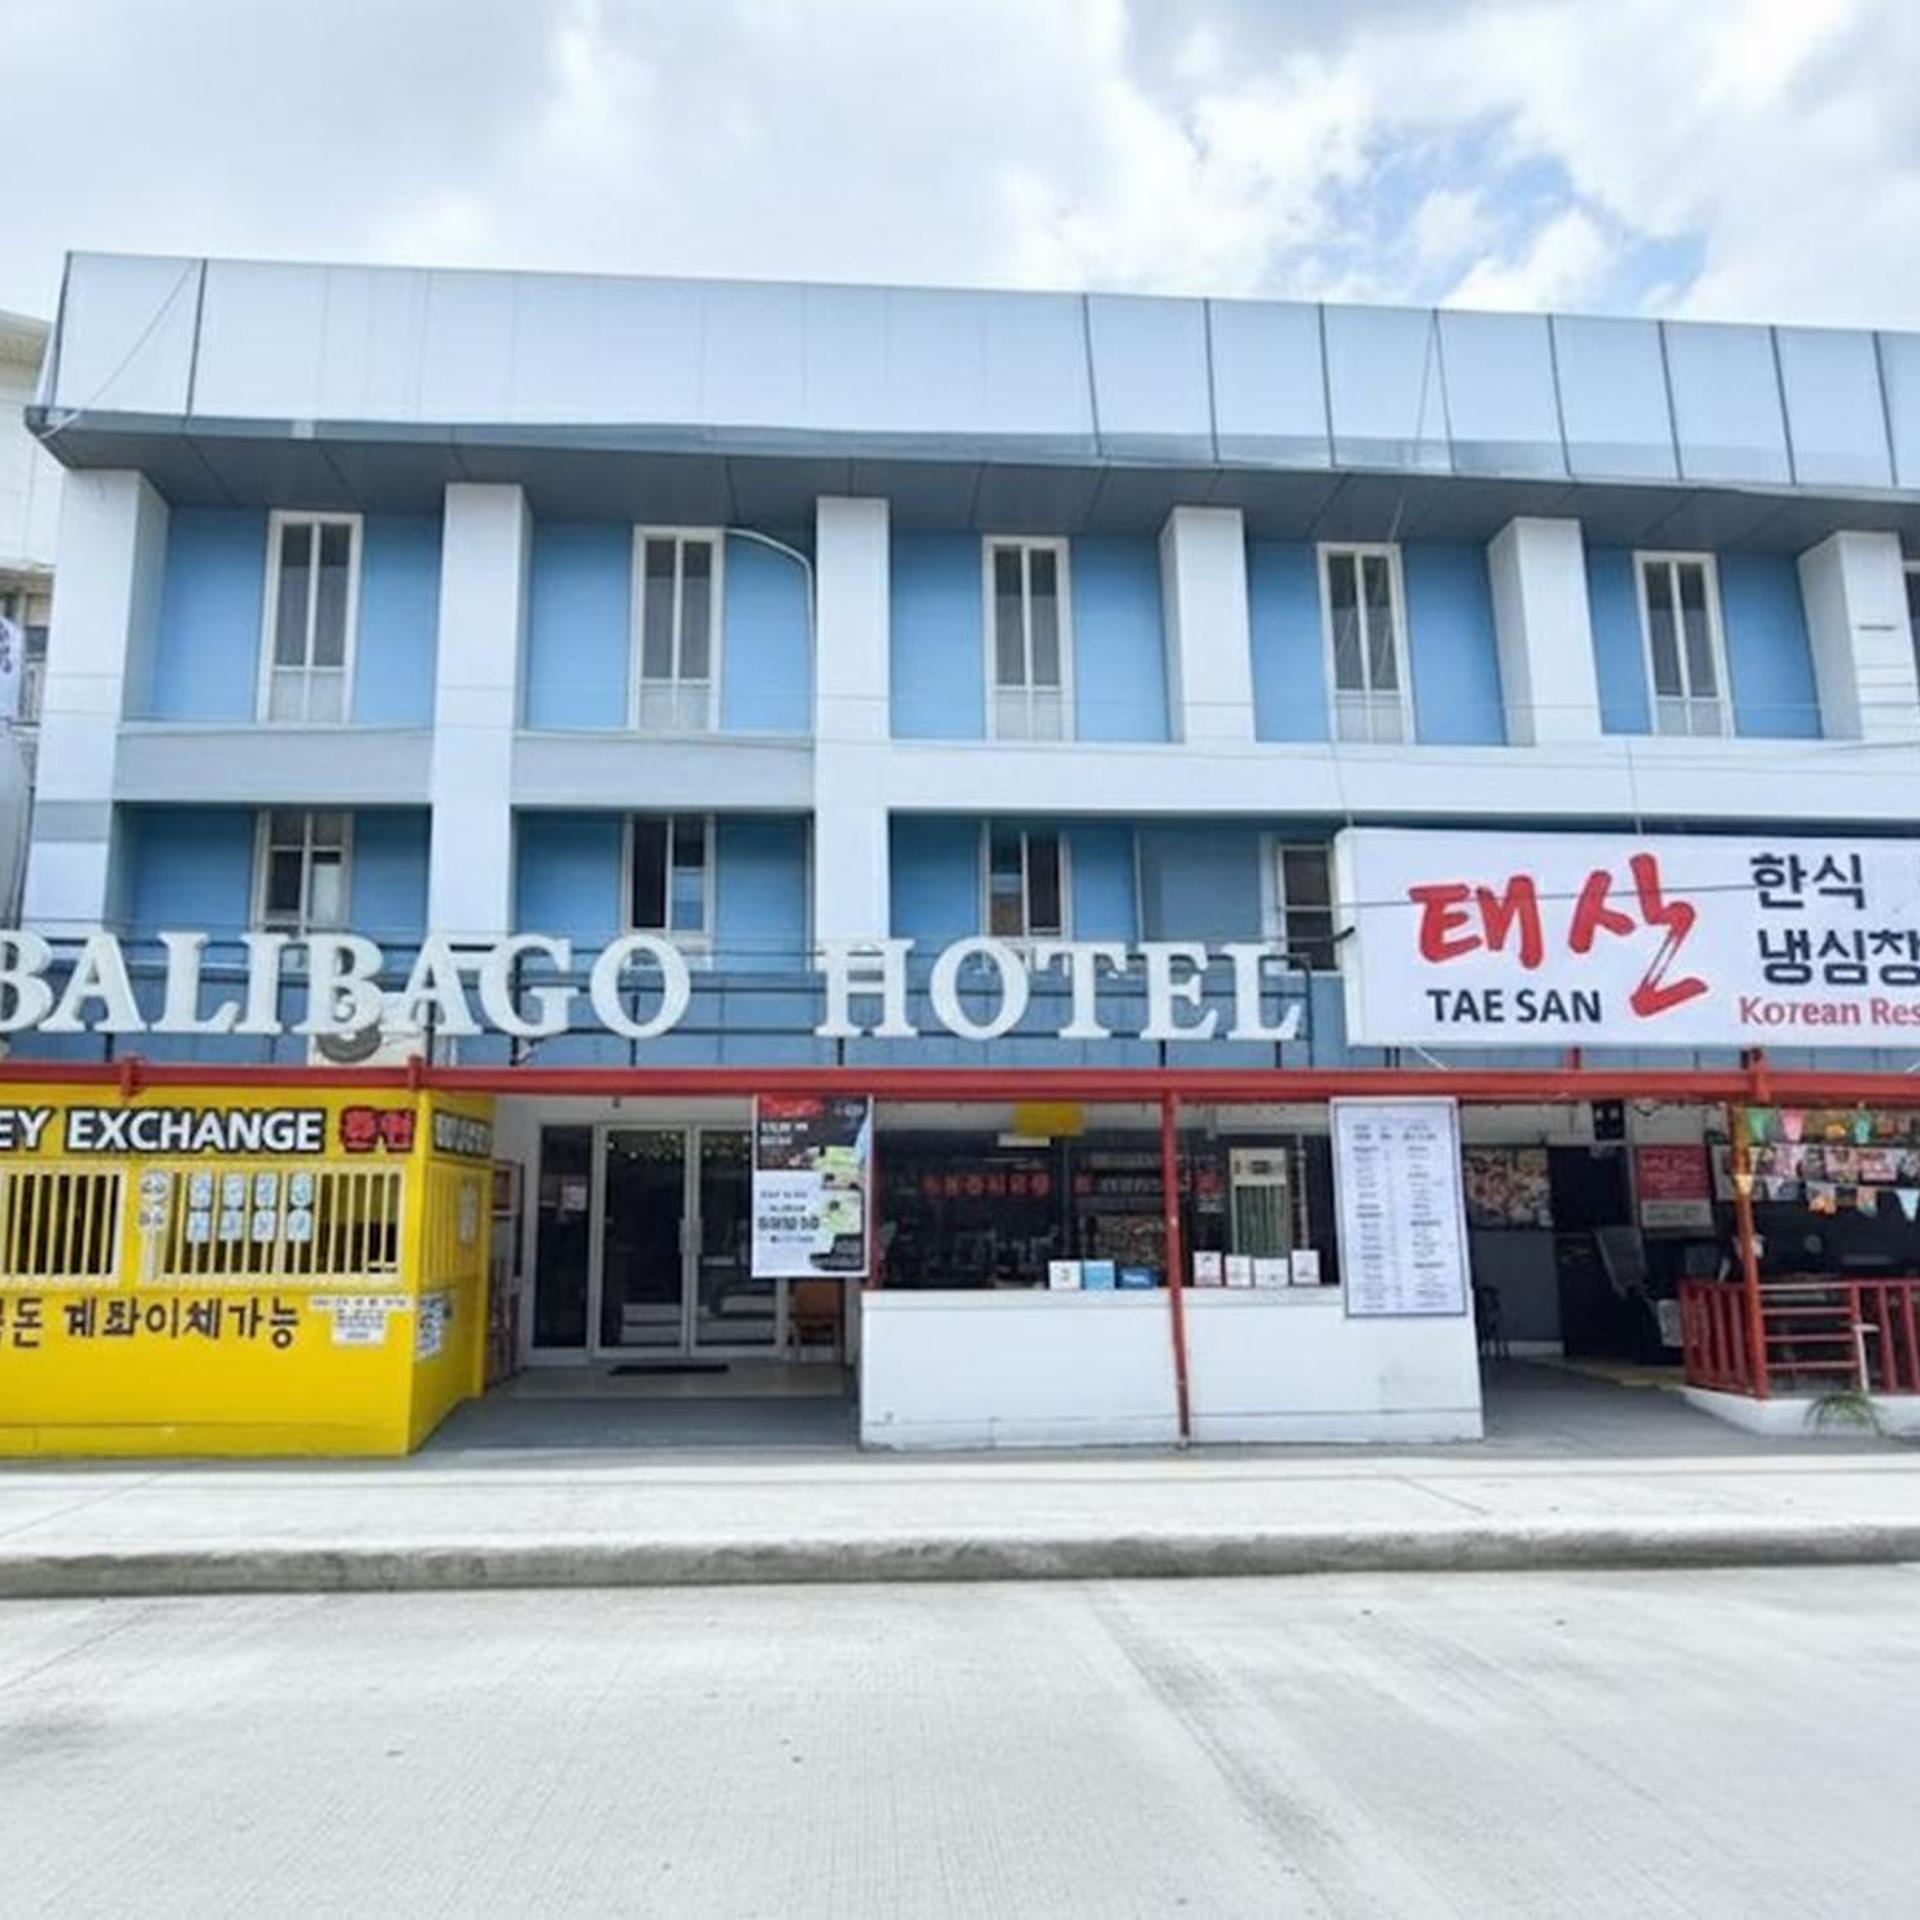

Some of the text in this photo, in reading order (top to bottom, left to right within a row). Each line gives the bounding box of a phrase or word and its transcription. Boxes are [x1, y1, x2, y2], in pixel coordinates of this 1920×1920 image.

[1750, 853, 1865, 910] 한식
[0, 932, 1301, 1042] BALIBAGO HOTEL
[1426, 987, 1602, 1024] TAE SAN
[1739, 997, 1862, 1026] Korean
[66, 1108, 324, 1151] EXCHANGE
[0, 1297, 43, 1348] 돈
